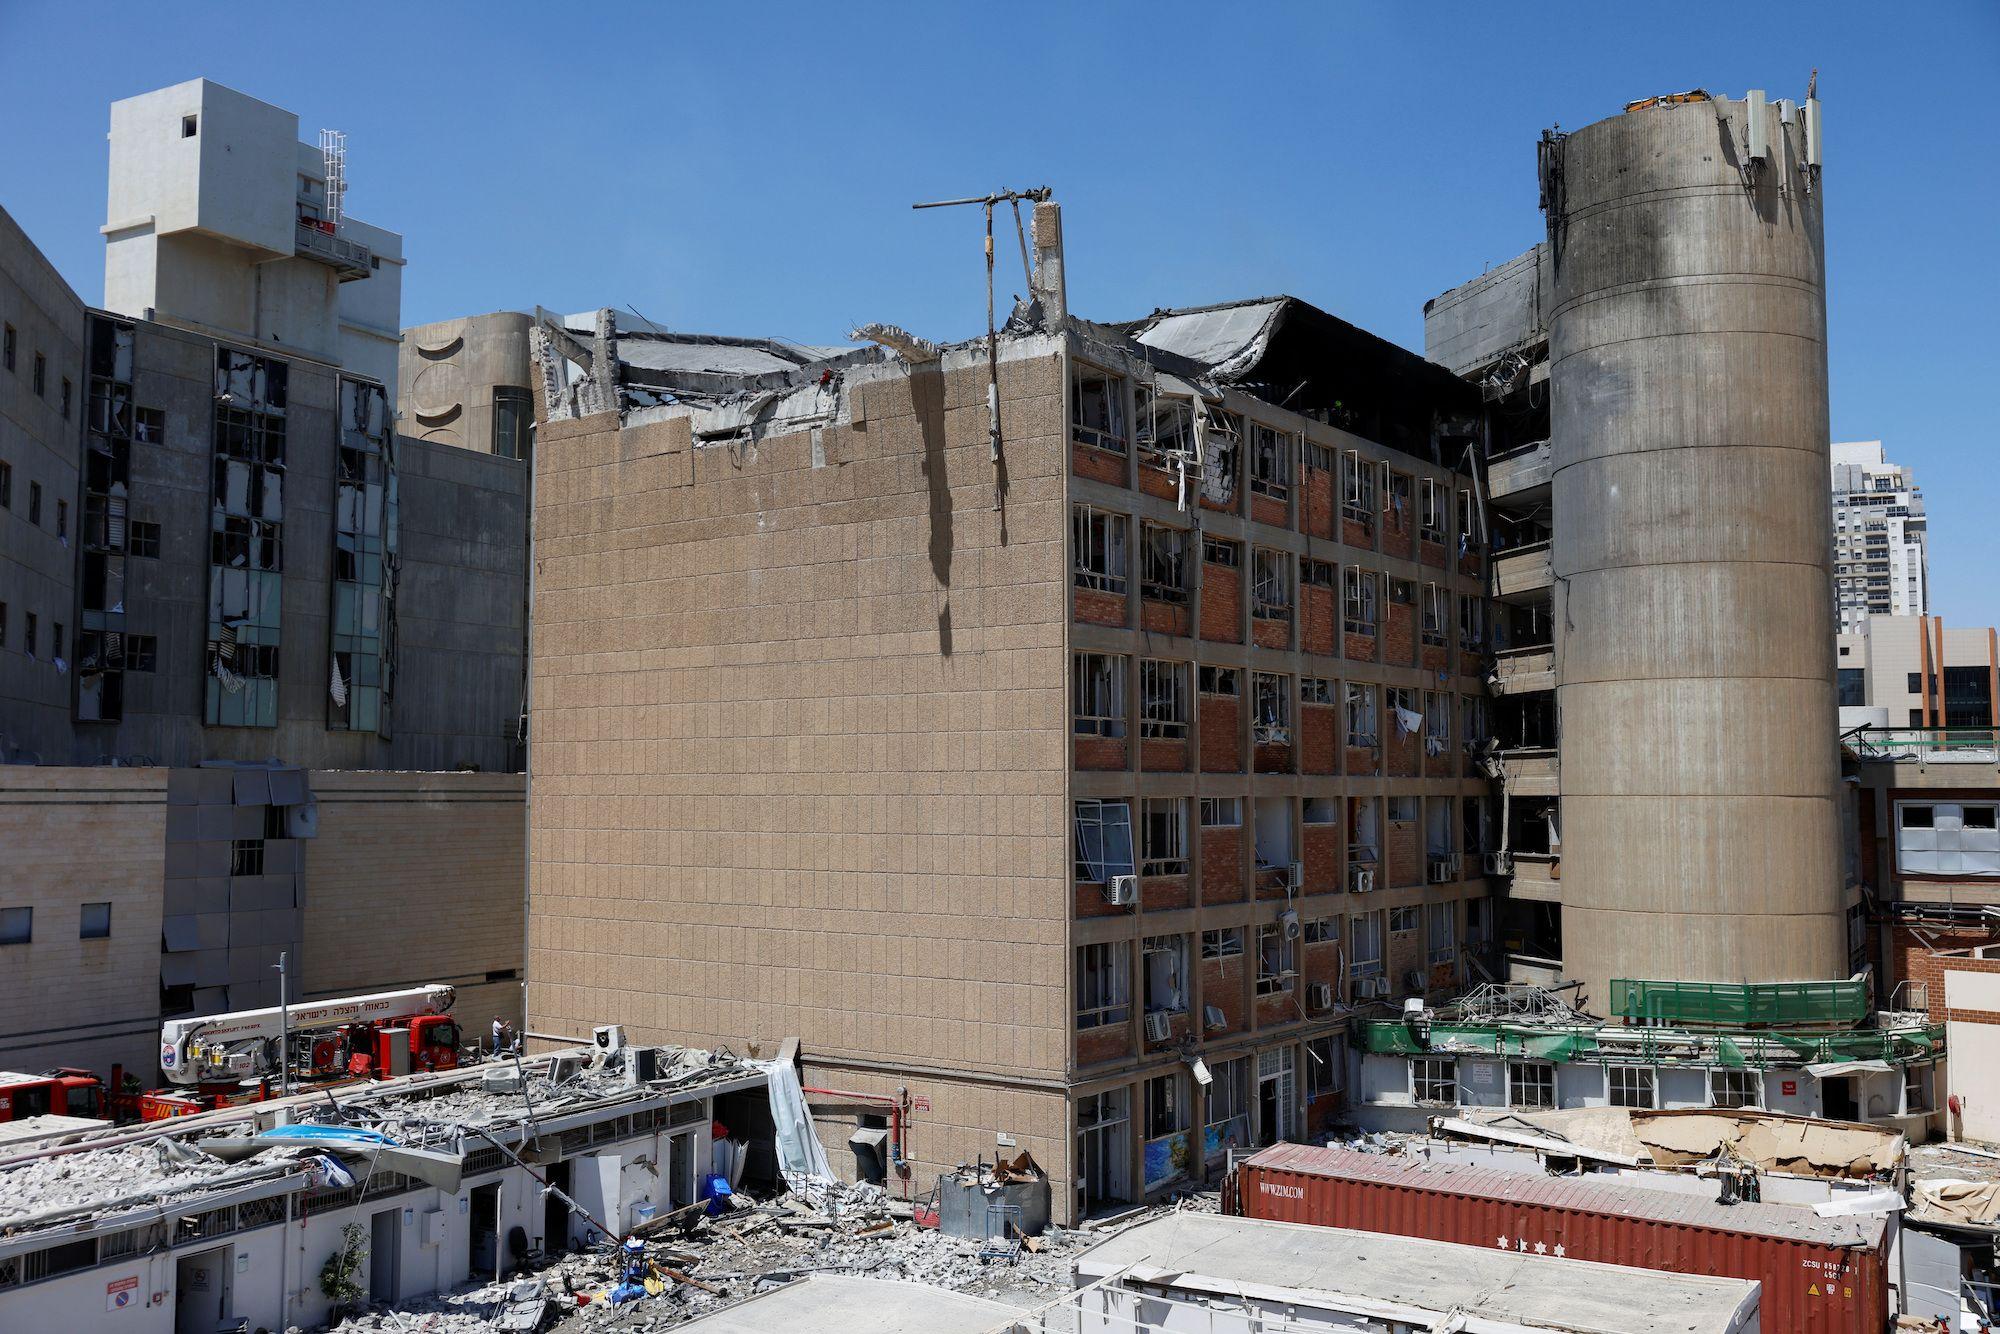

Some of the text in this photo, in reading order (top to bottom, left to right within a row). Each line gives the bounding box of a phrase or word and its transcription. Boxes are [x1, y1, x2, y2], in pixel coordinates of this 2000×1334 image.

[333, 1005, 358, 1016] והצלה
[364, 1001, 389, 1011] כבאות
[1802, 1260, 1821, 1269] ZCSU
